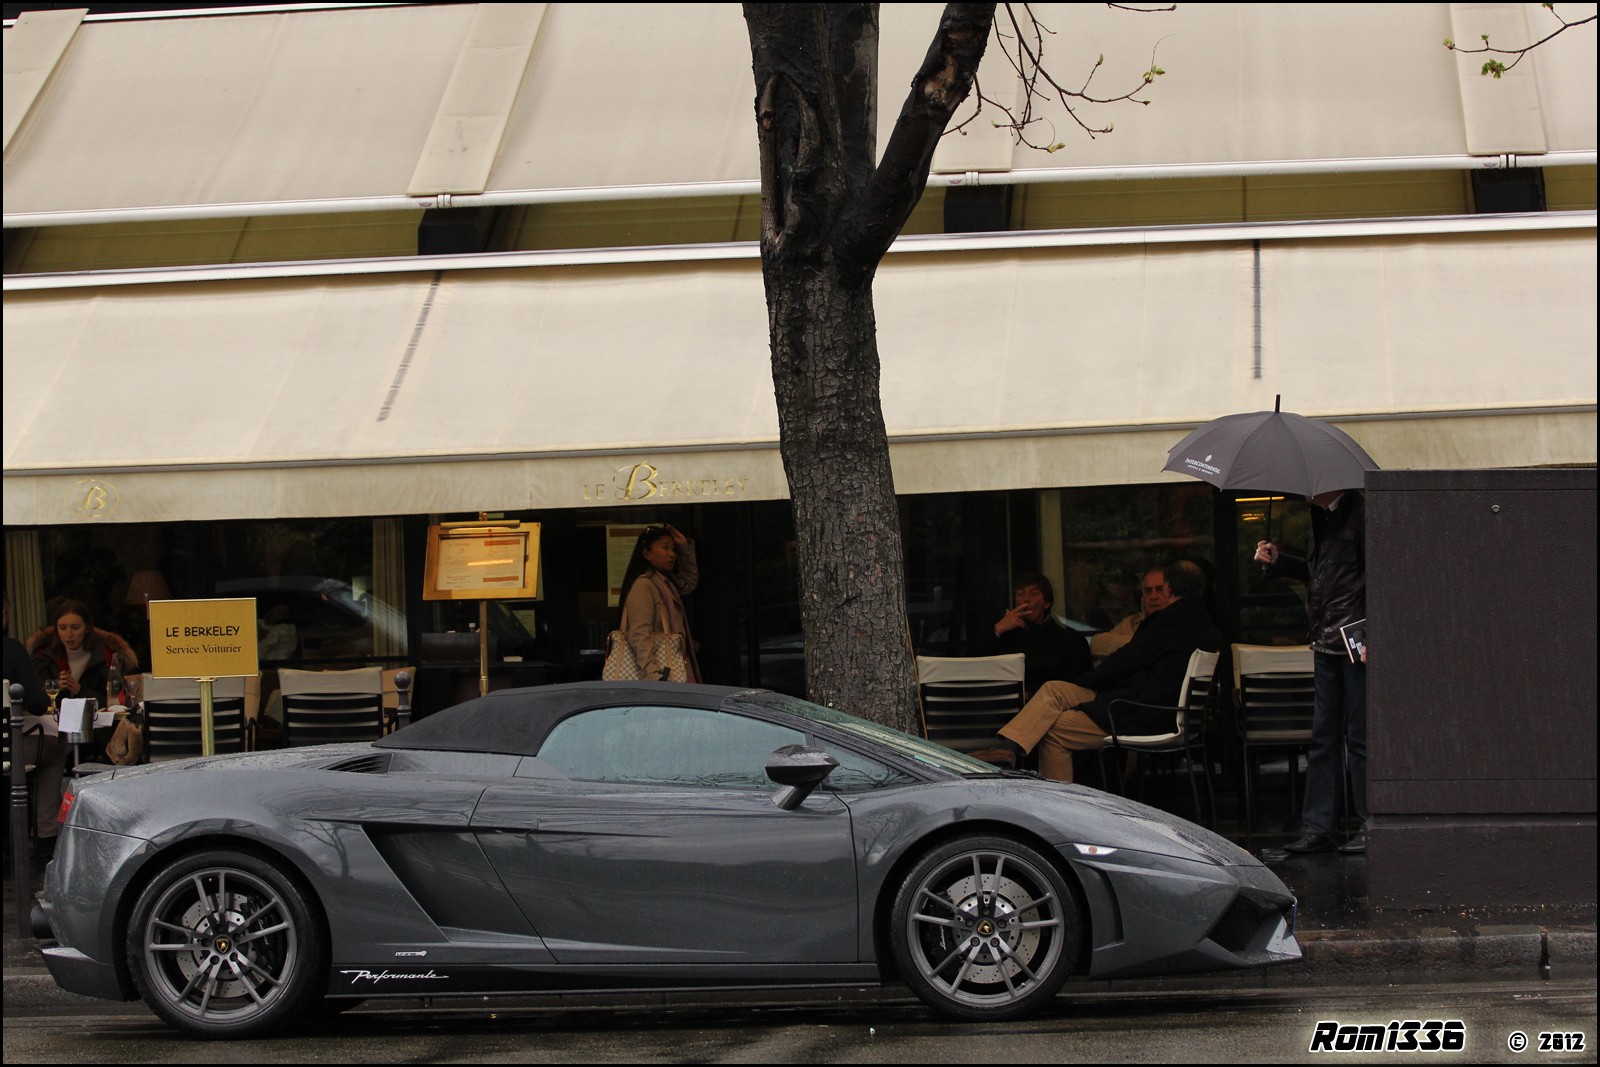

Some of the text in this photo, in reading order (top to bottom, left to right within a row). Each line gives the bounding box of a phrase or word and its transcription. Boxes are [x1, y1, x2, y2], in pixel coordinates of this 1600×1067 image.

[583, 484, 606, 501] LE
[165, 625, 241, 638] LE BERKELEY
[166, 643, 242, 654] Service Voiturier
[340, 969, 450, 984] Performante
